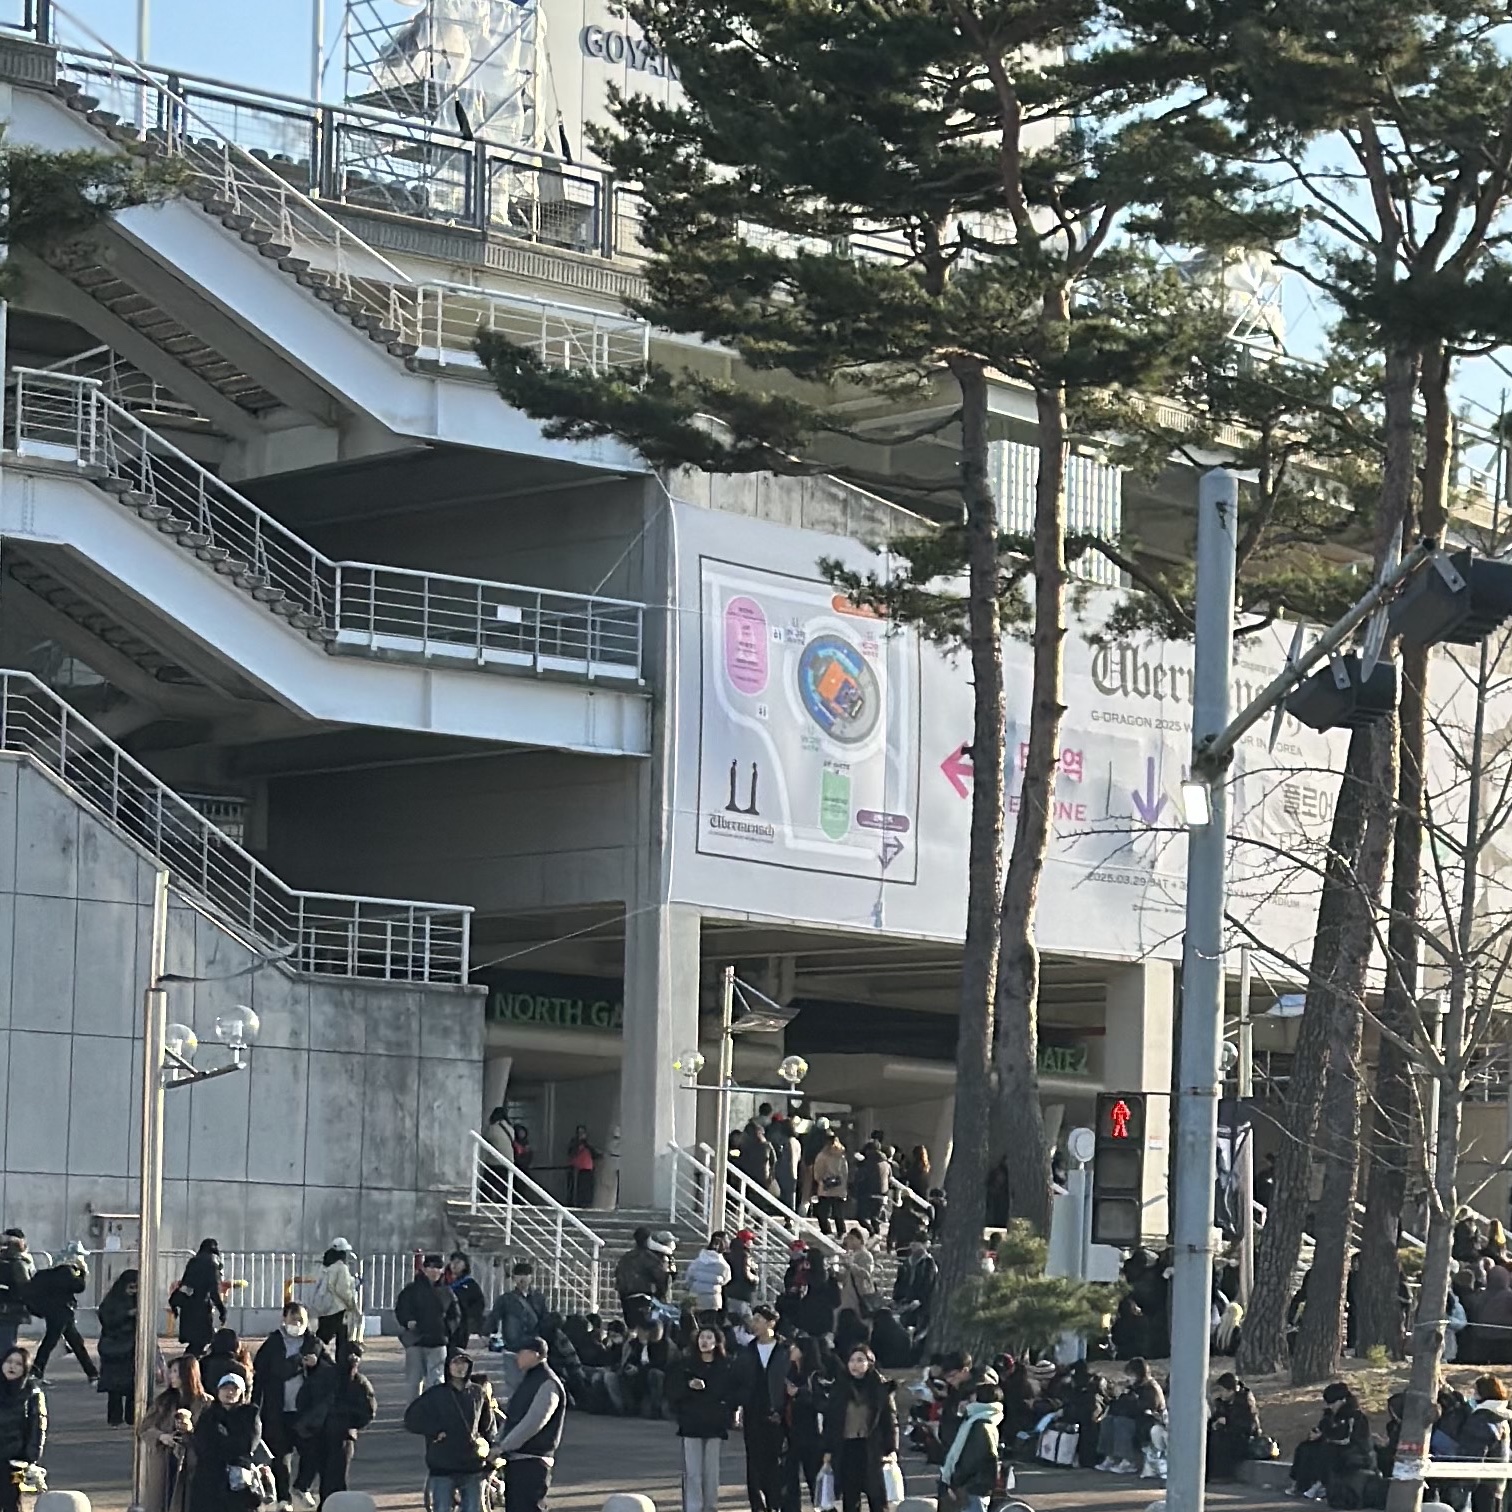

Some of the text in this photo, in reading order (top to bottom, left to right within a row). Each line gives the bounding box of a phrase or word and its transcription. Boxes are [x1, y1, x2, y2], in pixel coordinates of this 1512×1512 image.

[1091, 710, 1152, 728] G-DRAGON
[1154, 718, 1181, 732] 2025
[1276, 742, 1303, 757] OREA
[494, 992, 583, 1025] NORTH
